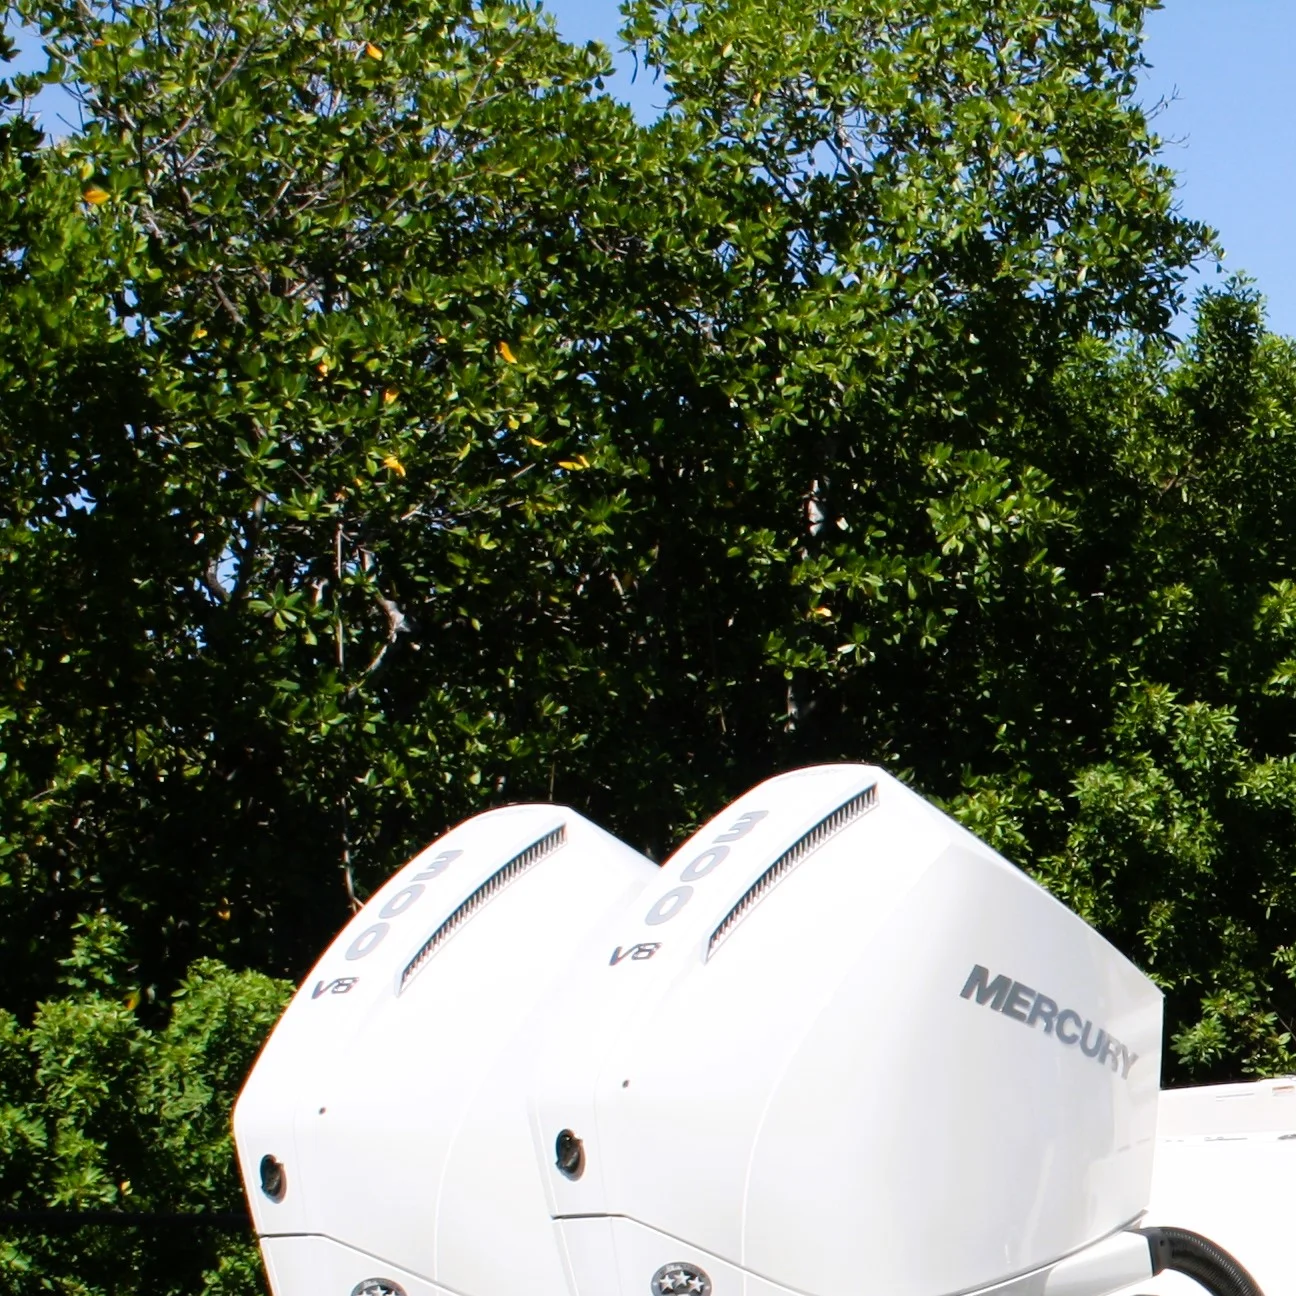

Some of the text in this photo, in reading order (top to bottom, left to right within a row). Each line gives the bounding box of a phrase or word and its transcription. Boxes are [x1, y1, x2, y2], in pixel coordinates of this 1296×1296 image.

[345, 849, 464, 961] 300
[644, 809, 770, 926] 300
[311, 976, 360, 1000] V8
[608, 941, 663, 967] V8
[959, 963, 1139, 1081] MERCURY
